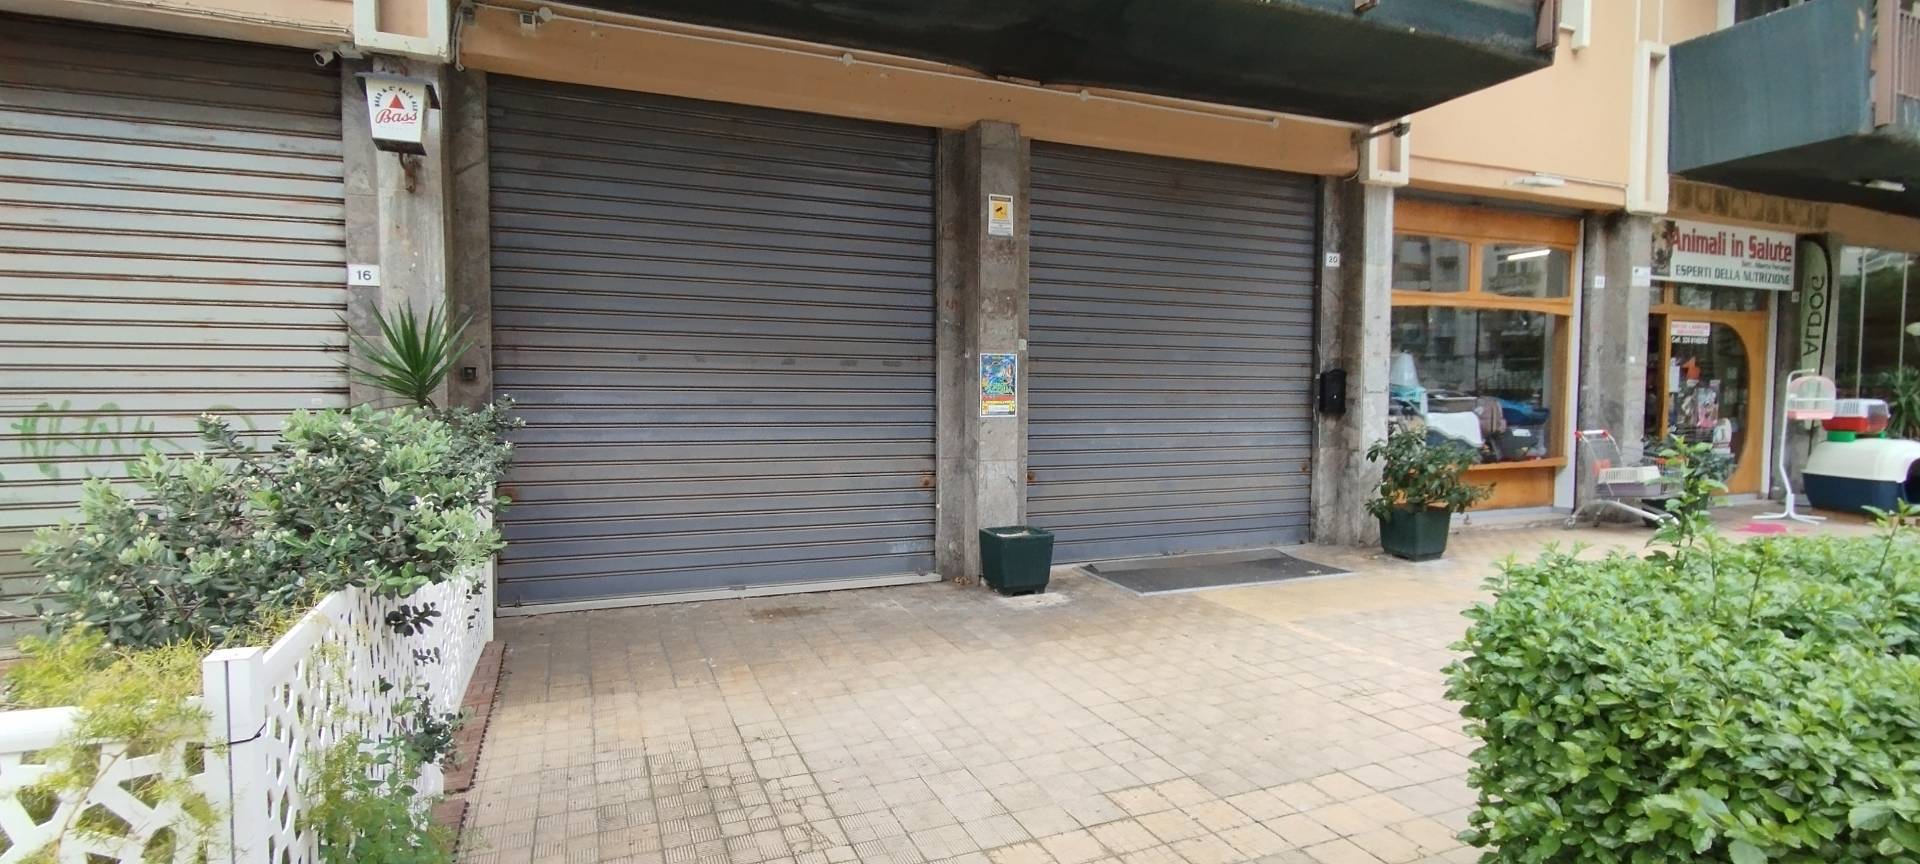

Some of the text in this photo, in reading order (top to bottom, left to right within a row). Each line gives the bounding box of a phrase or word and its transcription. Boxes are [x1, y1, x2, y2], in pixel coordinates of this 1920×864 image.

[375, 108, 417, 124] Bass
[1672, 226, 1792, 262] Animali in Salute
[356, 270, 372, 281] 16
[1675, 264, 1790, 285] ESPERTI DELLA NUTRIZIONE
